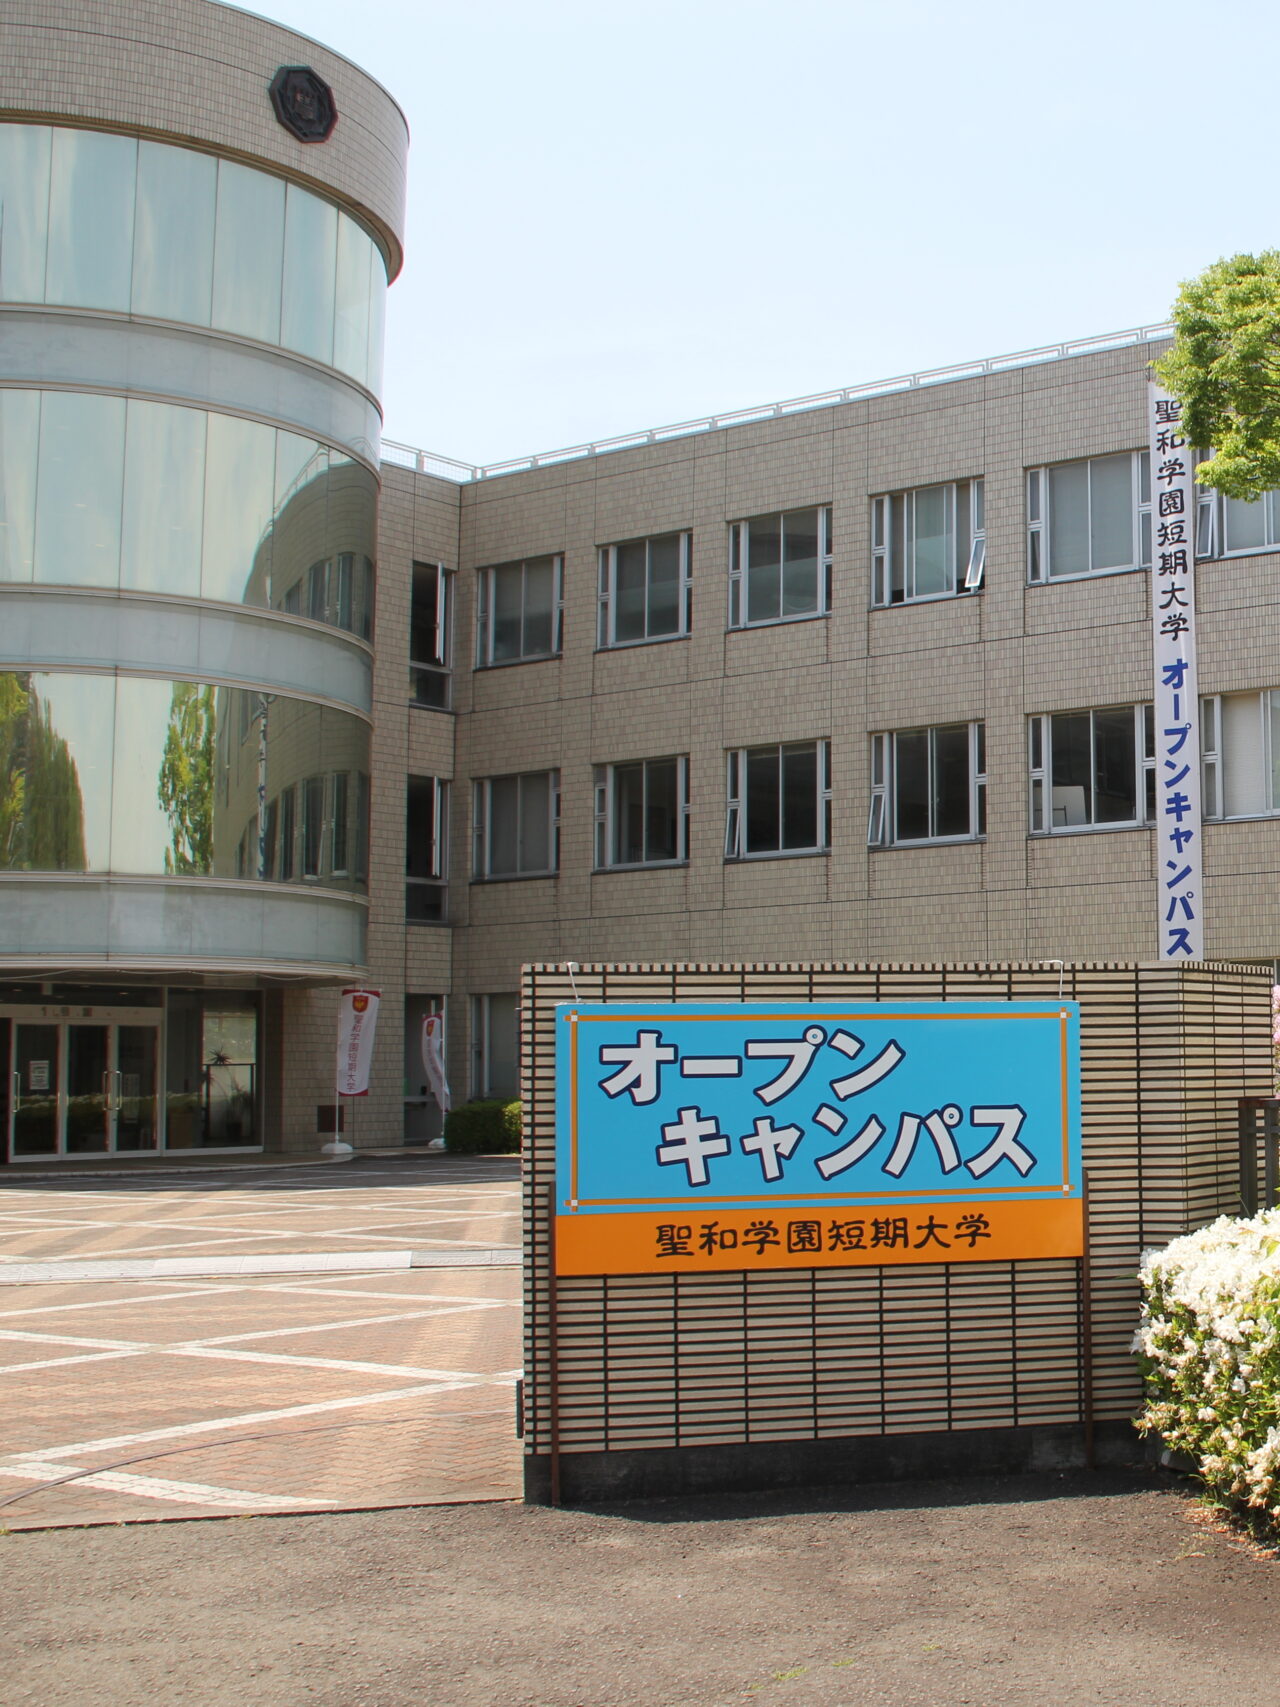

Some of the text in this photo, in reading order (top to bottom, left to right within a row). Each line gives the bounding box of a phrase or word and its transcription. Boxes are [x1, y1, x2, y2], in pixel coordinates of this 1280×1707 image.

[1154, 399, 1195, 957] 聖和学園短期大学 オープンキャンパス
[598, 1024, 906, 1106] オープン
[656, 1103, 1038, 1187] キャンパス
[655, 1213, 992, 1258] 聖和学園短期大学
